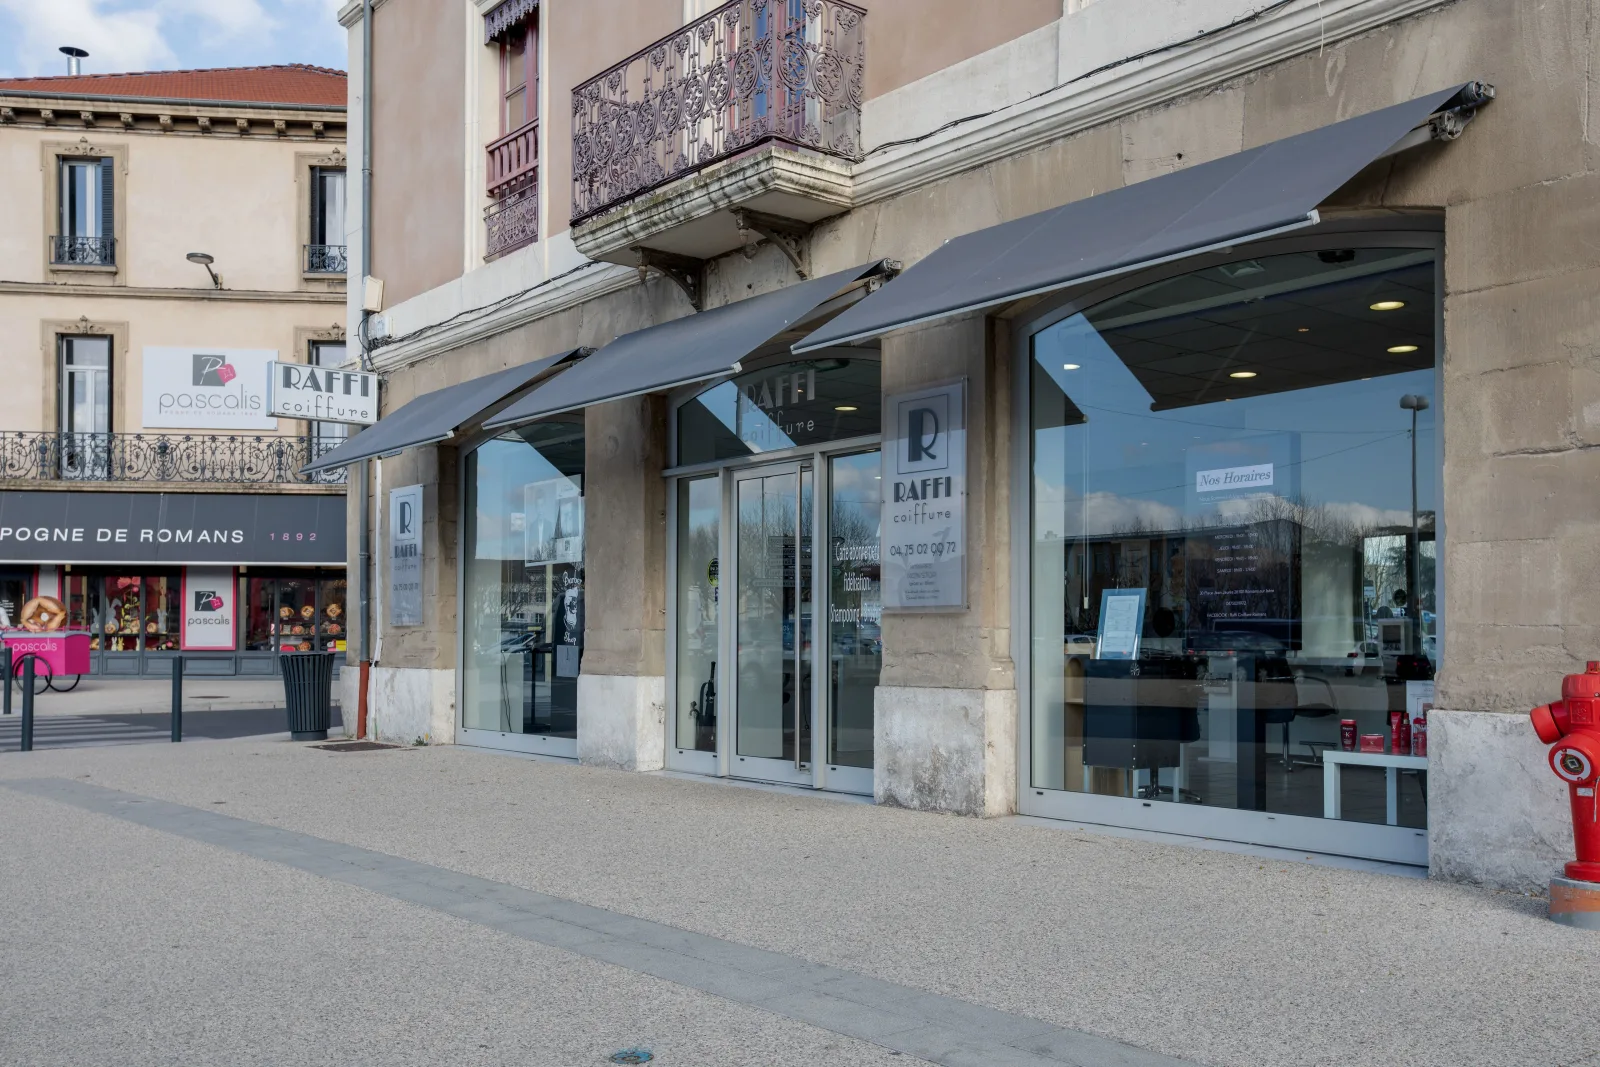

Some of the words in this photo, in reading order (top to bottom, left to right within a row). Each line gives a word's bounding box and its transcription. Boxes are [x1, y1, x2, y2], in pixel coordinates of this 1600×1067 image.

[282, 365, 370, 397] RAFFI
[741, 368, 815, 415] RAFFI
[159, 383, 261, 414] pascalis
[282, 394, 369, 419] coiffure
[742, 410, 815, 445] coiffure
[893, 476, 952, 503] RAFFI
[1199, 474, 1220, 487] Nos
[1223, 469, 1271, 485] Horaires
[893, 502, 952, 525] coiffure
[0, 527, 85, 542] POGNE
[96, 528, 128, 542] DE
[140, 529, 245, 544] ROMANS
[269, 532, 317, 541] 1892
[394, 544, 417, 558] RAFFI
[916, 543, 928, 555] 02
[187, 614, 230, 627] pascalis
[12, 637, 58, 655] pascalis
